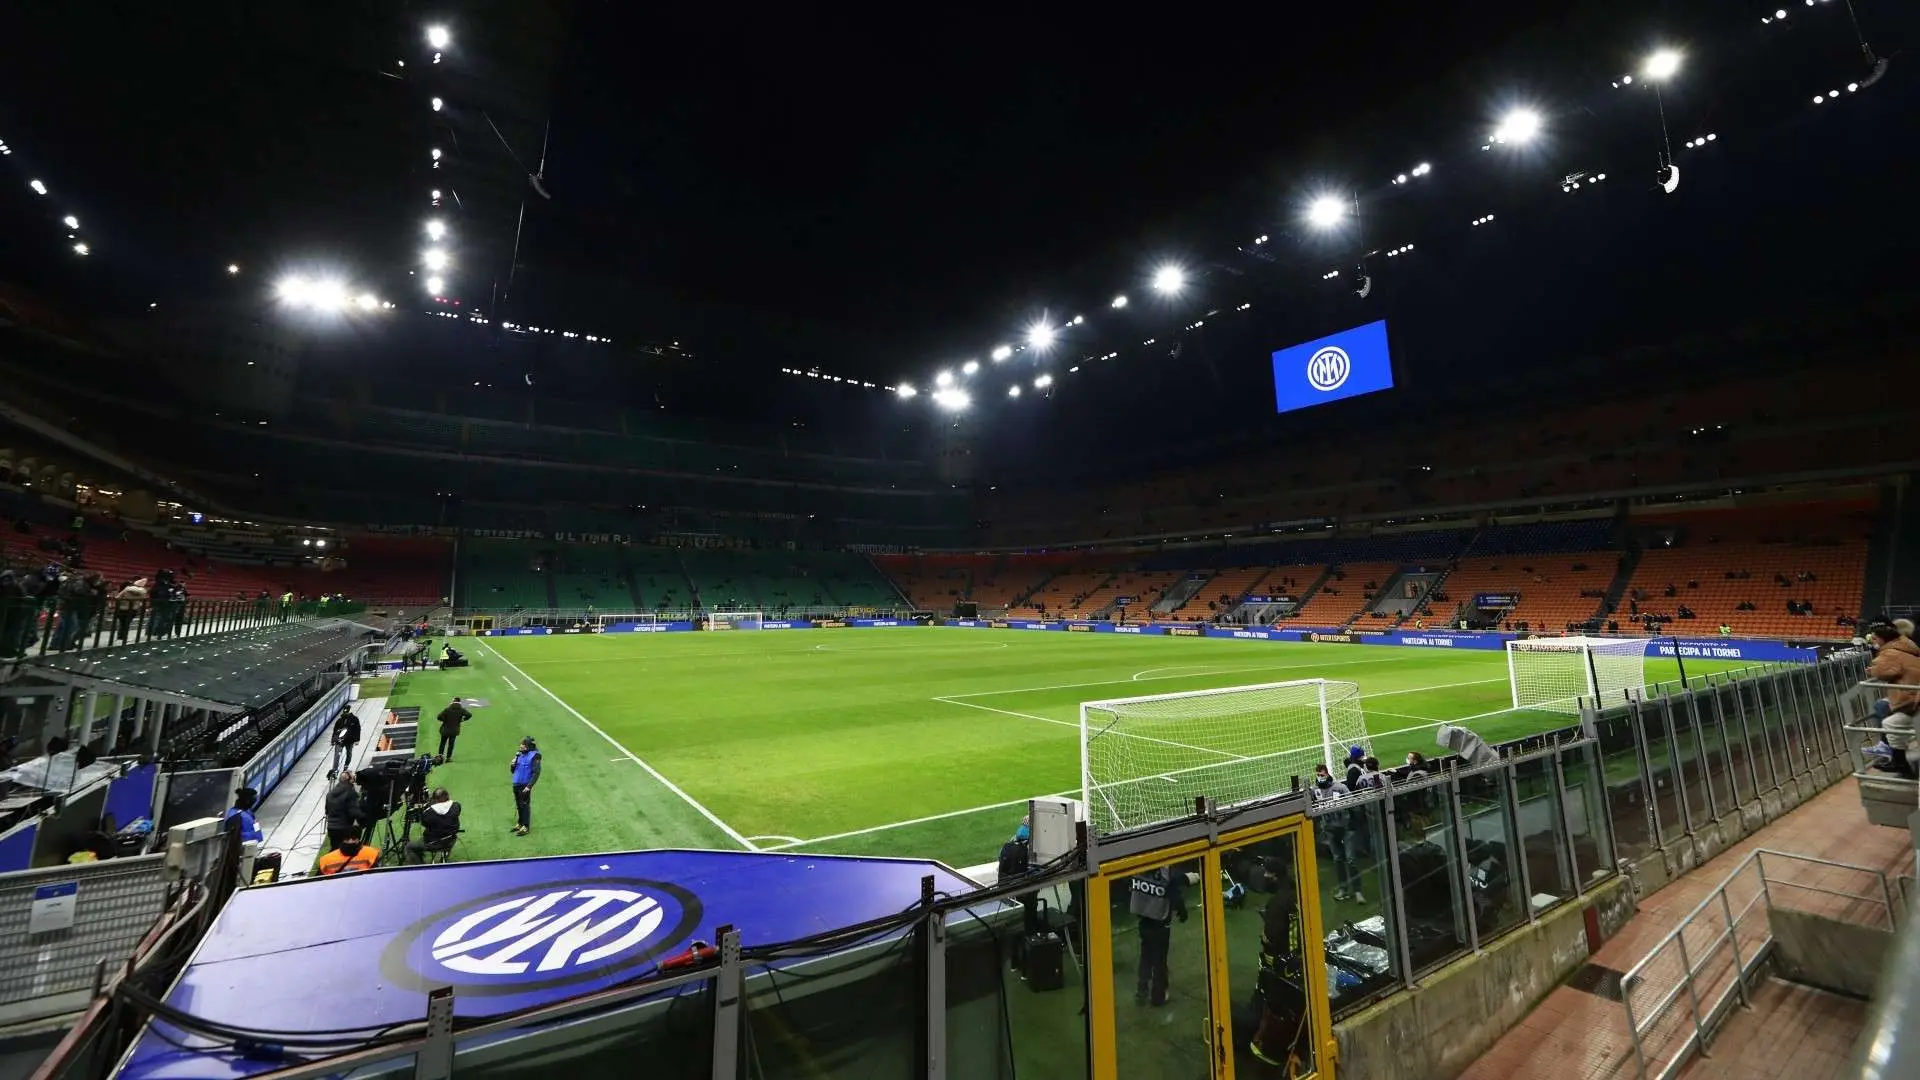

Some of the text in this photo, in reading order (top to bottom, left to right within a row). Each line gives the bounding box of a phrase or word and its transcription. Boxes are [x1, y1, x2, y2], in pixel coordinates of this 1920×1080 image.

[1659, 646, 1741, 658] PARECIPA AI TORNEI
[1132, 878, 1165, 896] HOTO
